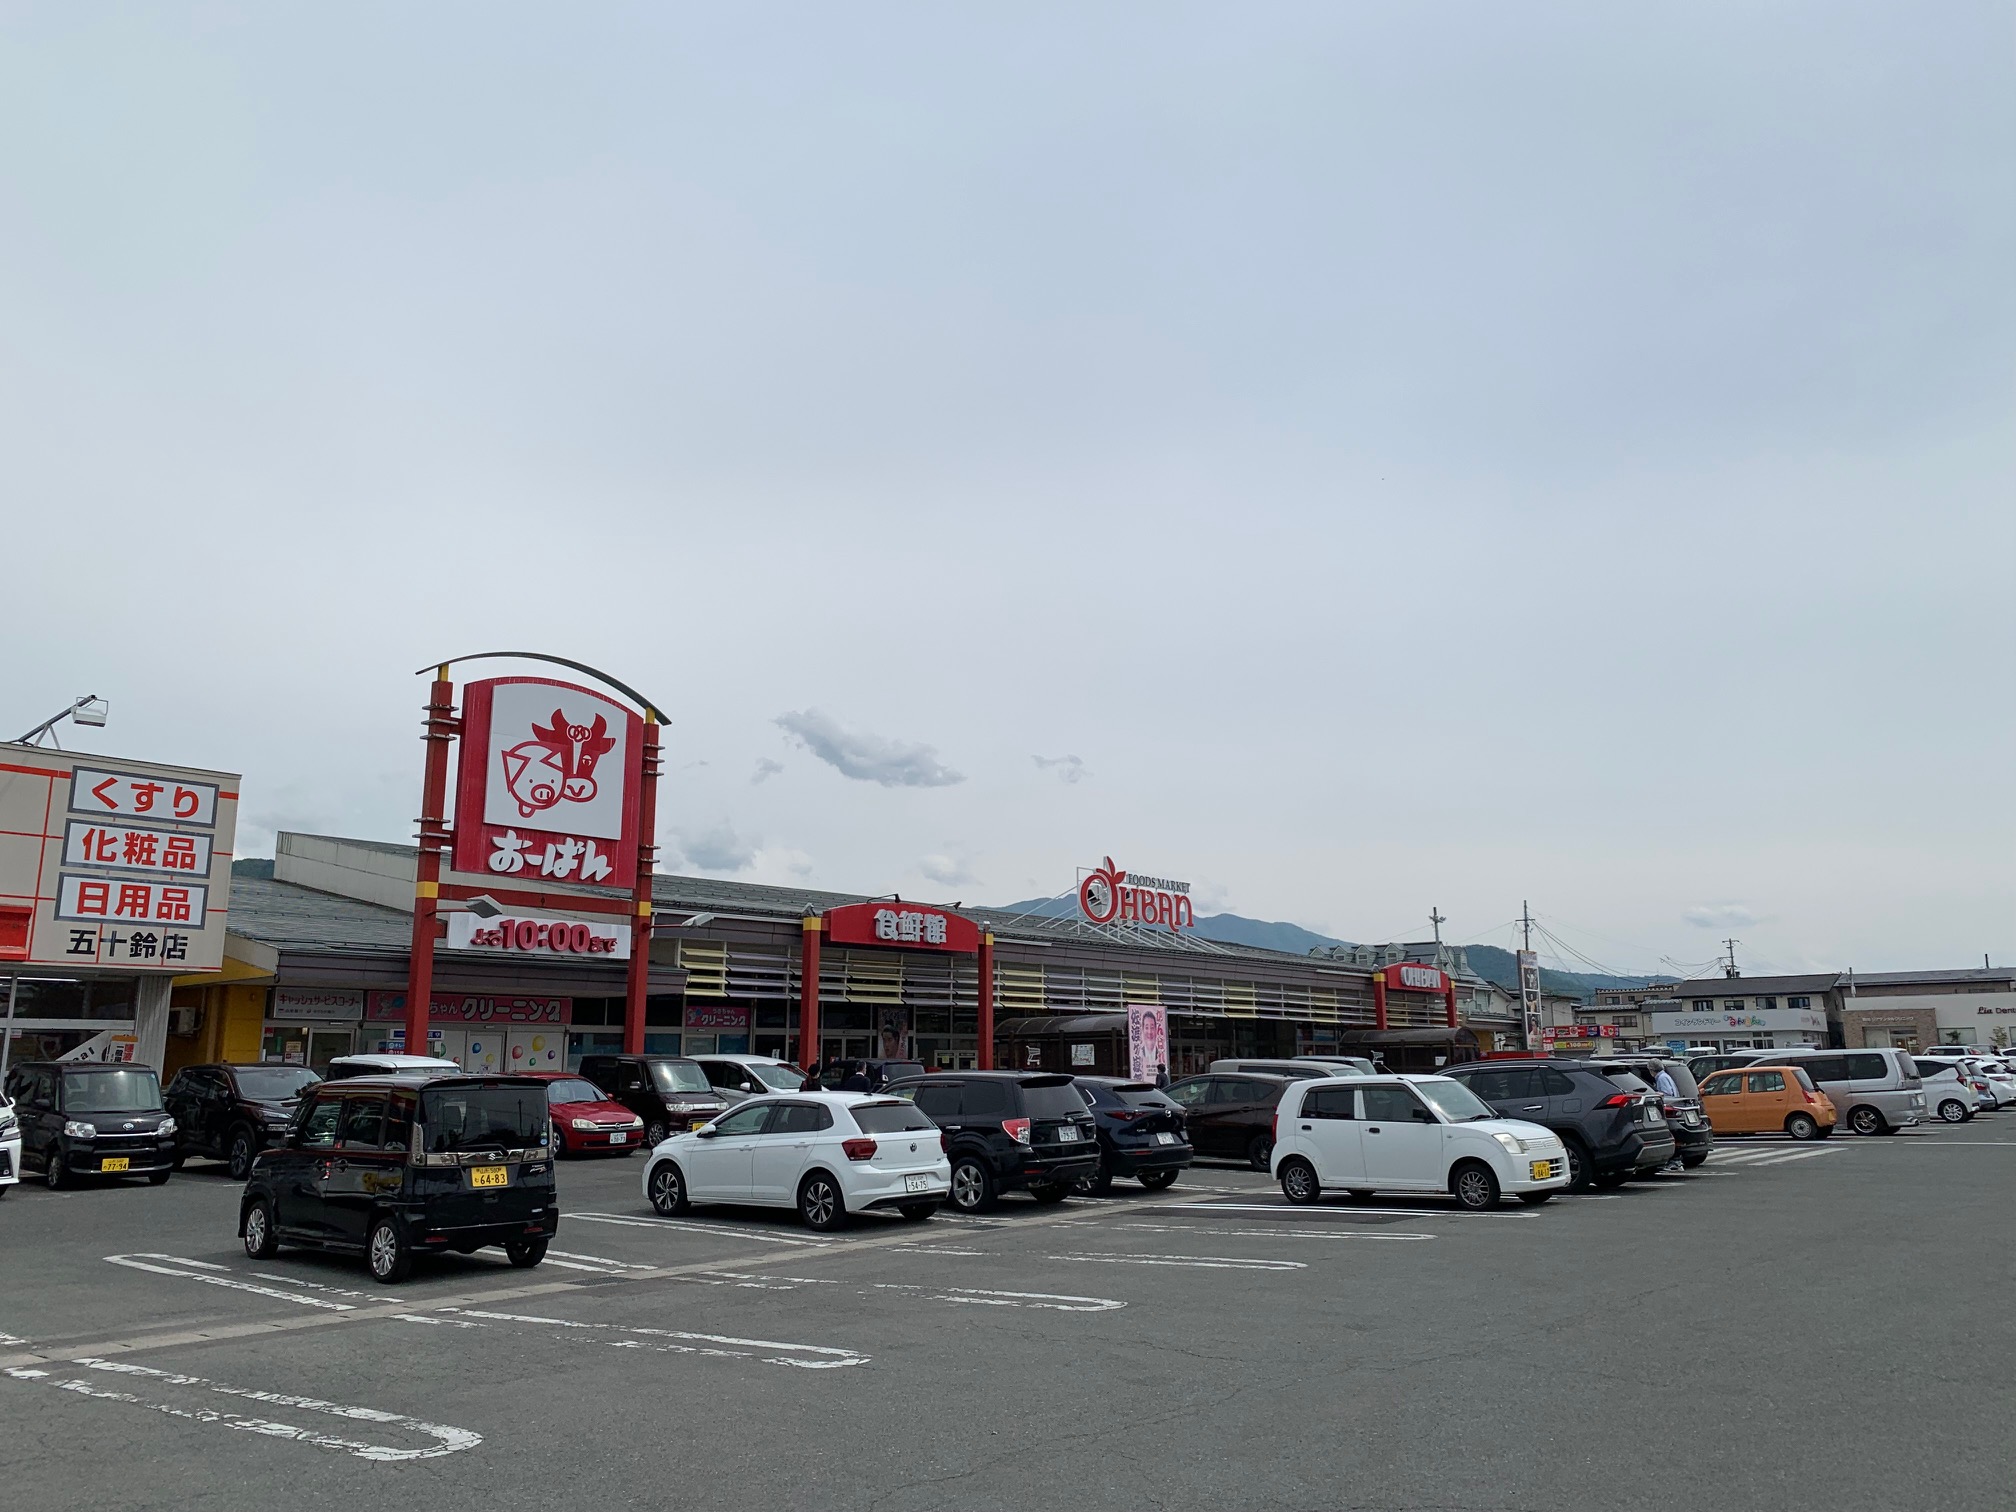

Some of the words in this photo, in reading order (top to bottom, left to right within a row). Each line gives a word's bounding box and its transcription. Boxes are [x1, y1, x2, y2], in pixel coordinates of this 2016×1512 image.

[91, 777, 200, 818] くすり
[82, 828, 197, 870] 化粧品
[487, 829, 613, 882] おーばん
[76, 881, 191, 922] 日用品
[1080, 866, 1195, 933] OHBAN
[1127, 873, 1156, 888] FOODS
[1157, 878, 1191, 894] MARKET
[873, 908, 947, 944] 食鮮館
[66, 929, 189, 960] 五十鈴店
[461, 998, 561, 1022] クリーニング
[701, 1014, 746, 1026] クリーニング
[480, 1173, 506, 1185] 64-83
